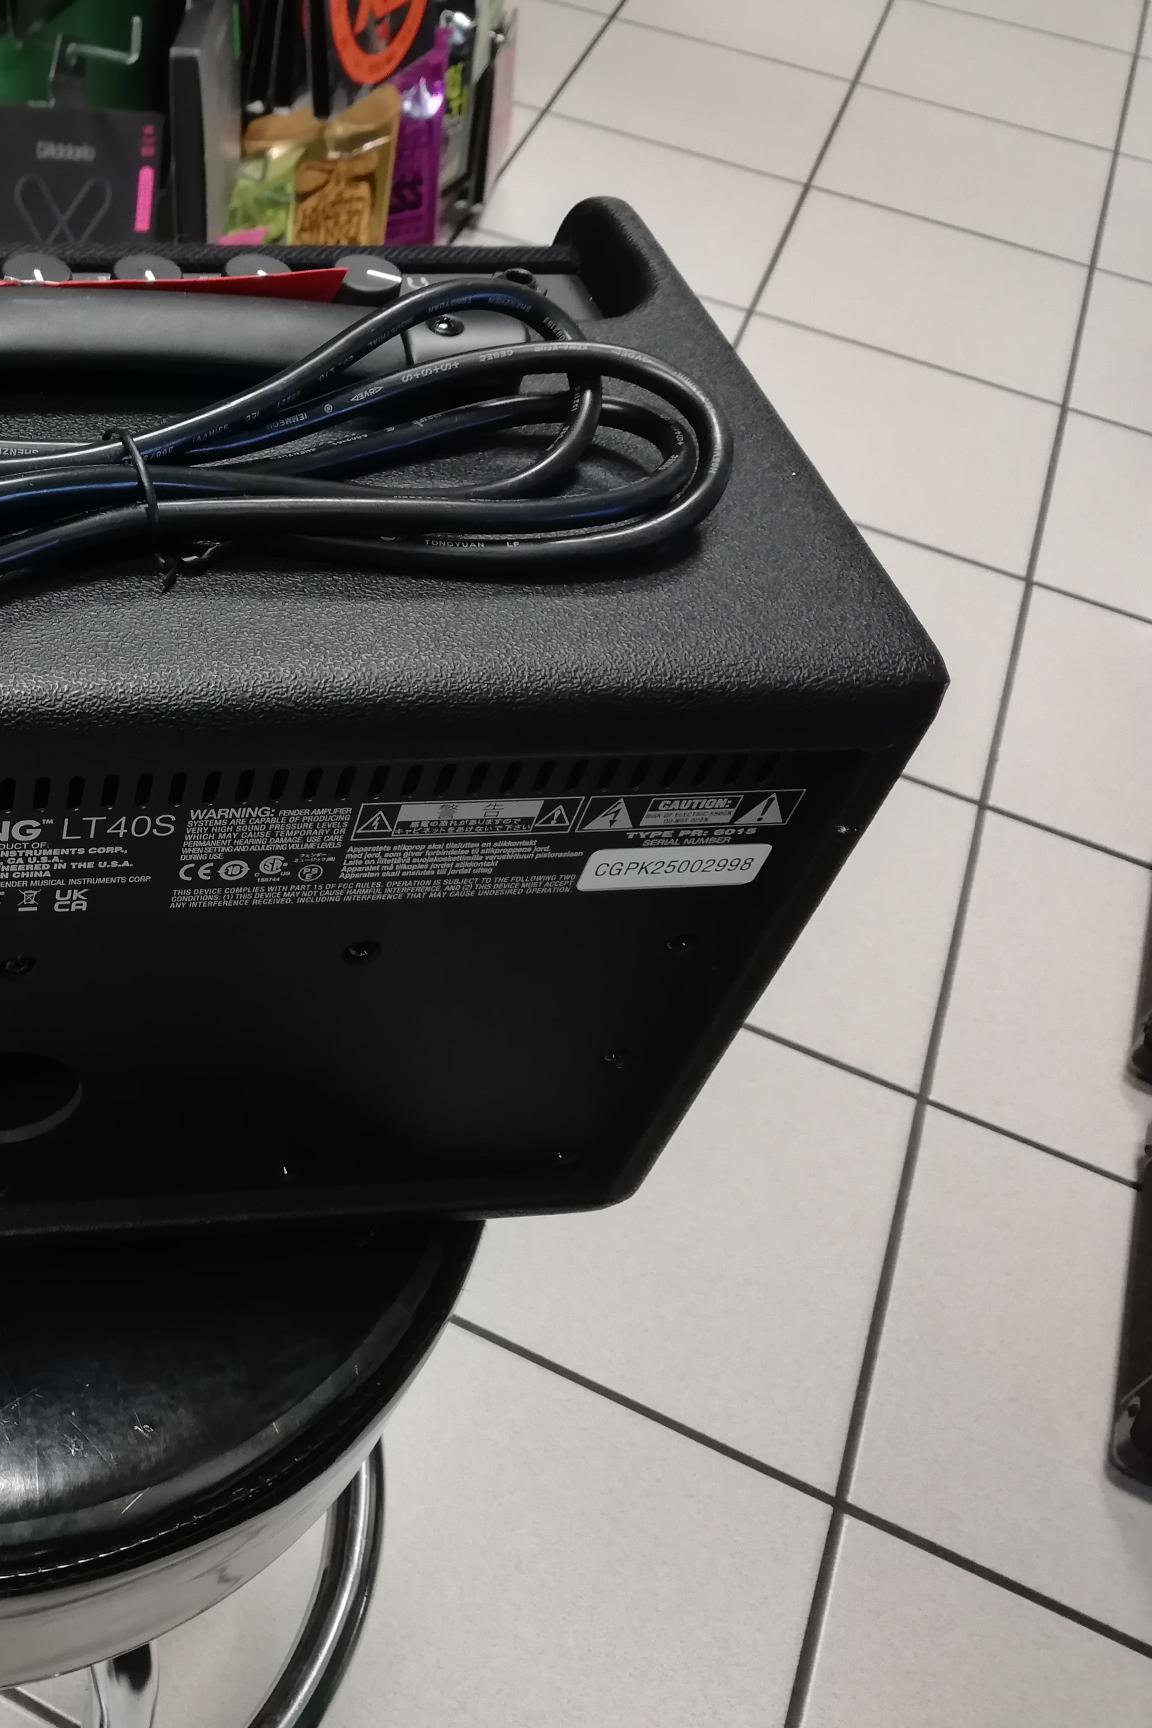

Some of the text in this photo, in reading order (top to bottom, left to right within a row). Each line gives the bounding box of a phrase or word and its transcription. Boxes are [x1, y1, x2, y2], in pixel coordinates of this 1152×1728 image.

[657, 798, 733, 811] CAUTION:
[190, 806, 352, 820] WARNING: FENDER AMPLIFIER
[62, 814, 176, 840] LT40S
[187, 819, 228, 828] SYSTEMS
[248, 816, 287, 825] CAPABLE
[302, 814, 351, 823] PRODUCING
[186, 821, 348, 834] VERY HIGH SOUND PRESSURE LEVELS
[626, 827, 759, 839] TYPE PR: 6015
[182, 834, 345, 848] PERMANENT HEARING USE CARE
[184, 833, 215, 841] WHICH
[217, 832, 239, 840] MAY
[241, 830, 271, 839] CAUSE
[275, 829, 332, 838] TEMPORARY
[641, 836, 732, 847] SERIAL NUMBER
[6, 857, 25, 865] CA
[28, 855, 64, 864] U.S.A.
[53, 862, 67, 870] IN
[70, 861, 95, 869] THE
[98, 860, 134, 868] U.S.A.
[593, 856, 755, 877] CGPK25002998
[11, 870, 52, 879] CHINA
[29, 878, 66, 888] MUSICAL
[68, 876, 127, 886] INSTRUMENTS
[193, 887, 223, 895] DEVICE
[224, 886, 265, 894] COMPLIES
[289, 884, 312, 892] PART
[338, 882, 354, 890] FCC
[386, 879, 431, 888] OPERATION
[443, 878, 479, 886] SUBJECT
[494, 876, 510, 884] THE
[510, 874, 557, 883] FOLLOWING
[55, 889, 89, 901] UK
